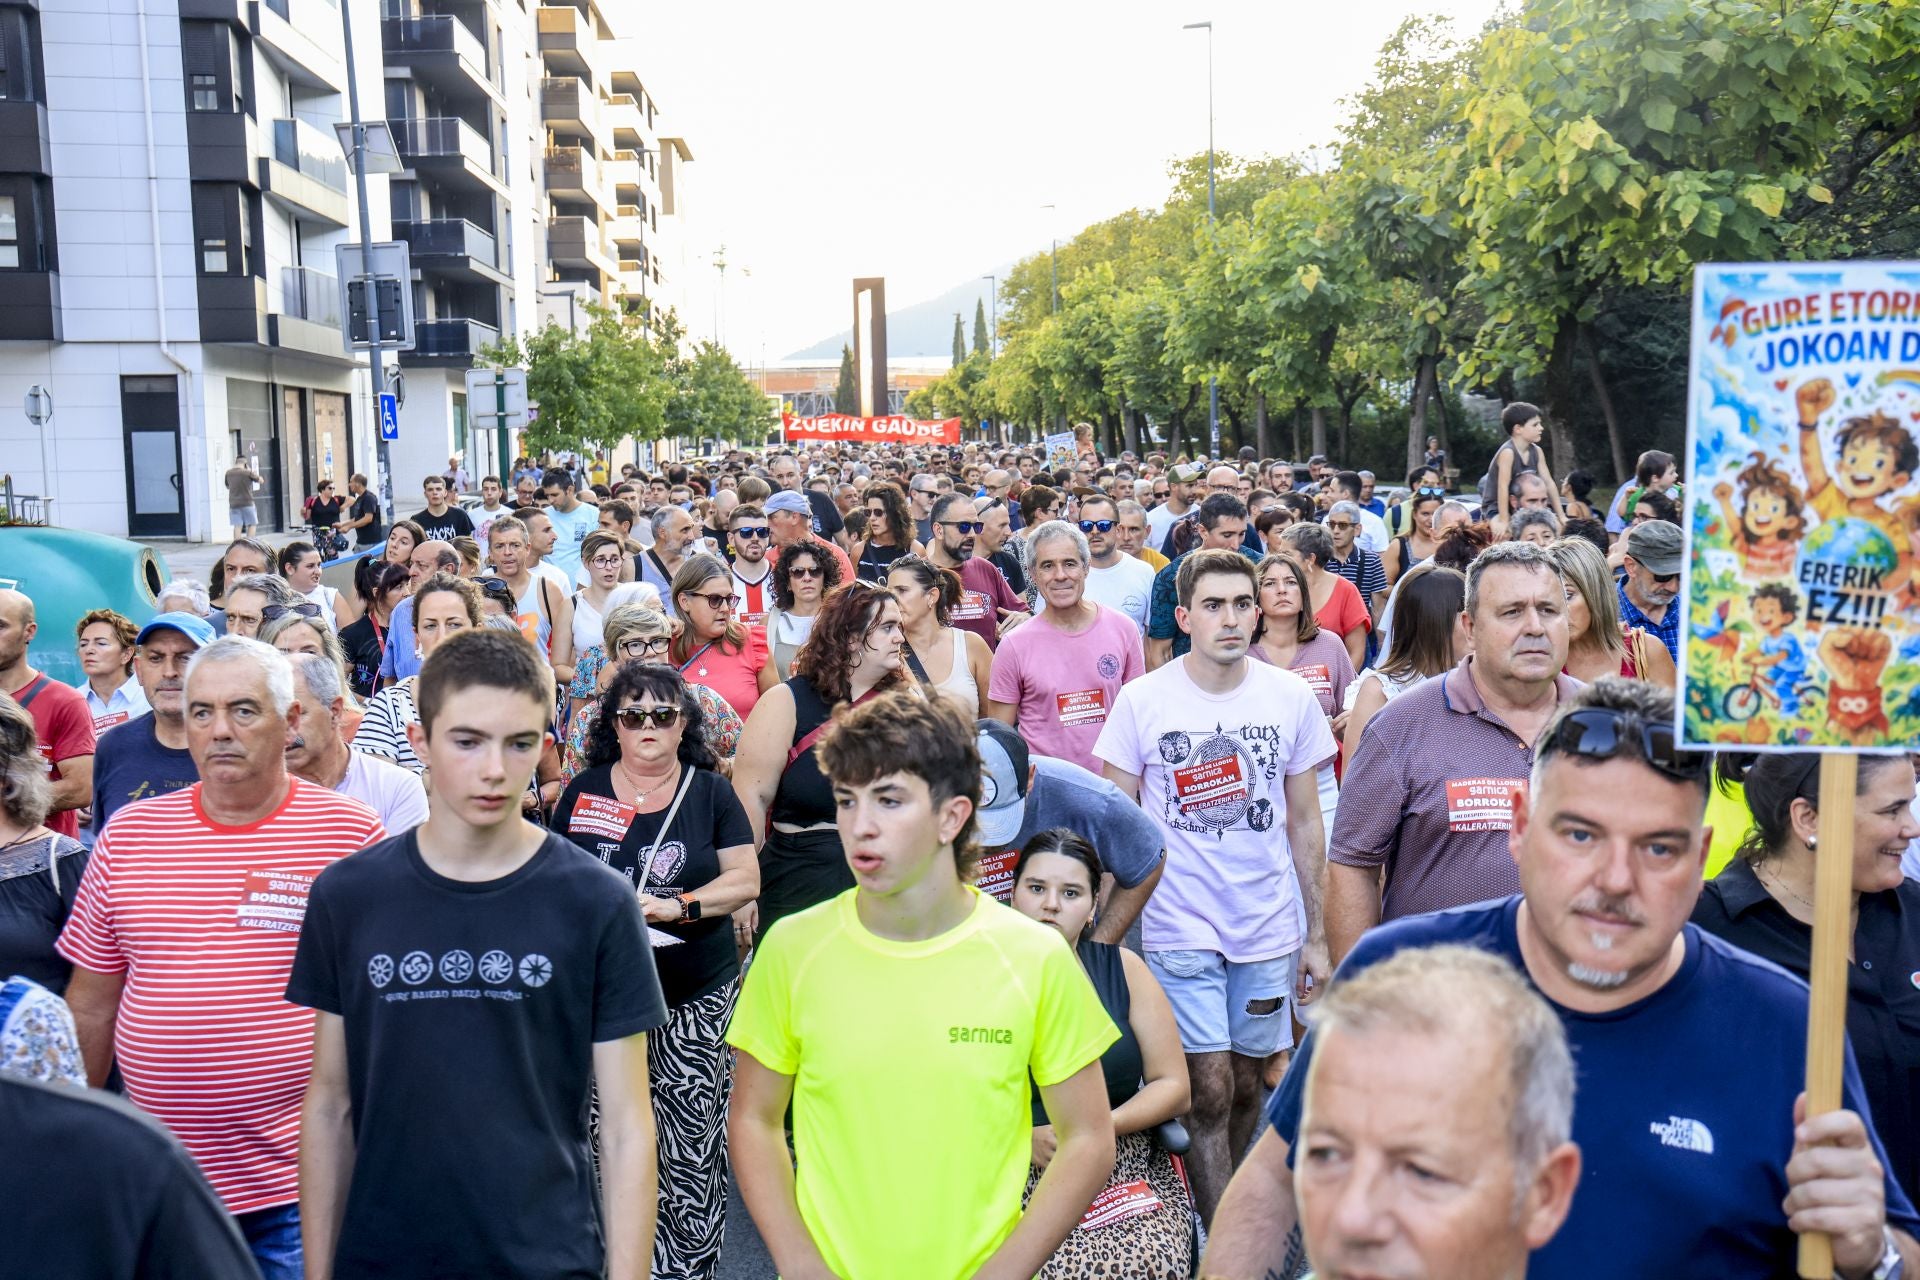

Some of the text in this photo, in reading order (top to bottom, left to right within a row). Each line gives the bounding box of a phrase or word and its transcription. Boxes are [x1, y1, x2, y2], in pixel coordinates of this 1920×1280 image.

[1742, 294, 1822, 338] GURE
[1756, 330, 1920, 374] JOKOAN D
[788, 417, 945, 437] ZUEKIN GAUDE
[1800, 560, 1884, 590] ERERIK
[1806, 589, 1887, 628] EZ!!!
[1062, 702, 1100, 713] BORROKAN
[1177, 766, 1204, 776] MADERAS
[1212, 758, 1233, 767] LLODIO
[1192, 767, 1223, 782] garnica
[1184, 774, 1235, 793] BORROKAN
[1451, 779, 1486, 788] MADERAS
[1469, 786, 1508, 795] garnica
[582, 794, 606, 802] MADERAS
[614, 802, 634, 810] LLODIO
[591, 801, 620, 813] garnica
[1186, 796, 1232, 811] KALERATZERIK
[1457, 798, 1512, 807] BORROKA
[578, 808, 626, 824] BORROKAN
[992, 851, 1015, 861] LLODIO
[251, 871, 291, 880] MADERAS
[268, 880, 311, 893] garnic
[250, 892, 308, 907] BORROK
[241, 919, 302, 932] KALERATZER
[949, 1027, 1013, 1044] garnica
[1669, 1116, 1690, 1128] THE
[1650, 1121, 1690, 1140] NORTH
[1661, 1133, 1690, 1149] FACE
[1116, 1181, 1140, 1189] LLODIO
[1084, 1192, 1146, 1219] BORROKAN
[1092, 1188, 1129, 1207] garnica
[1090, 1208, 1145, 1230] KALERATZERIK
